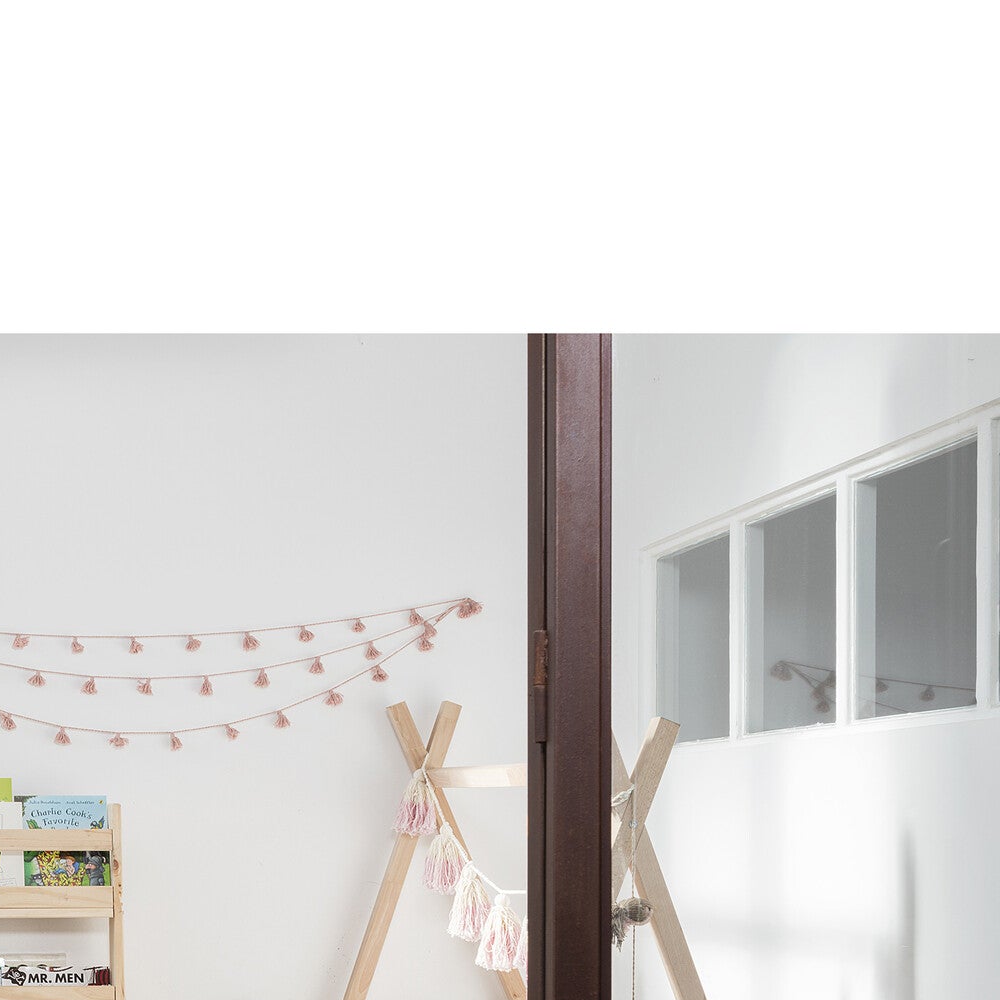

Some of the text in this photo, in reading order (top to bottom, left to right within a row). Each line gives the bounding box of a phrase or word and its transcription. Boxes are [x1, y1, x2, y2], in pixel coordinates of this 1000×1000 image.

[30, 807, 93, 820] Charlie Cook's
[28, 973, 84, 983] MR. MEN
